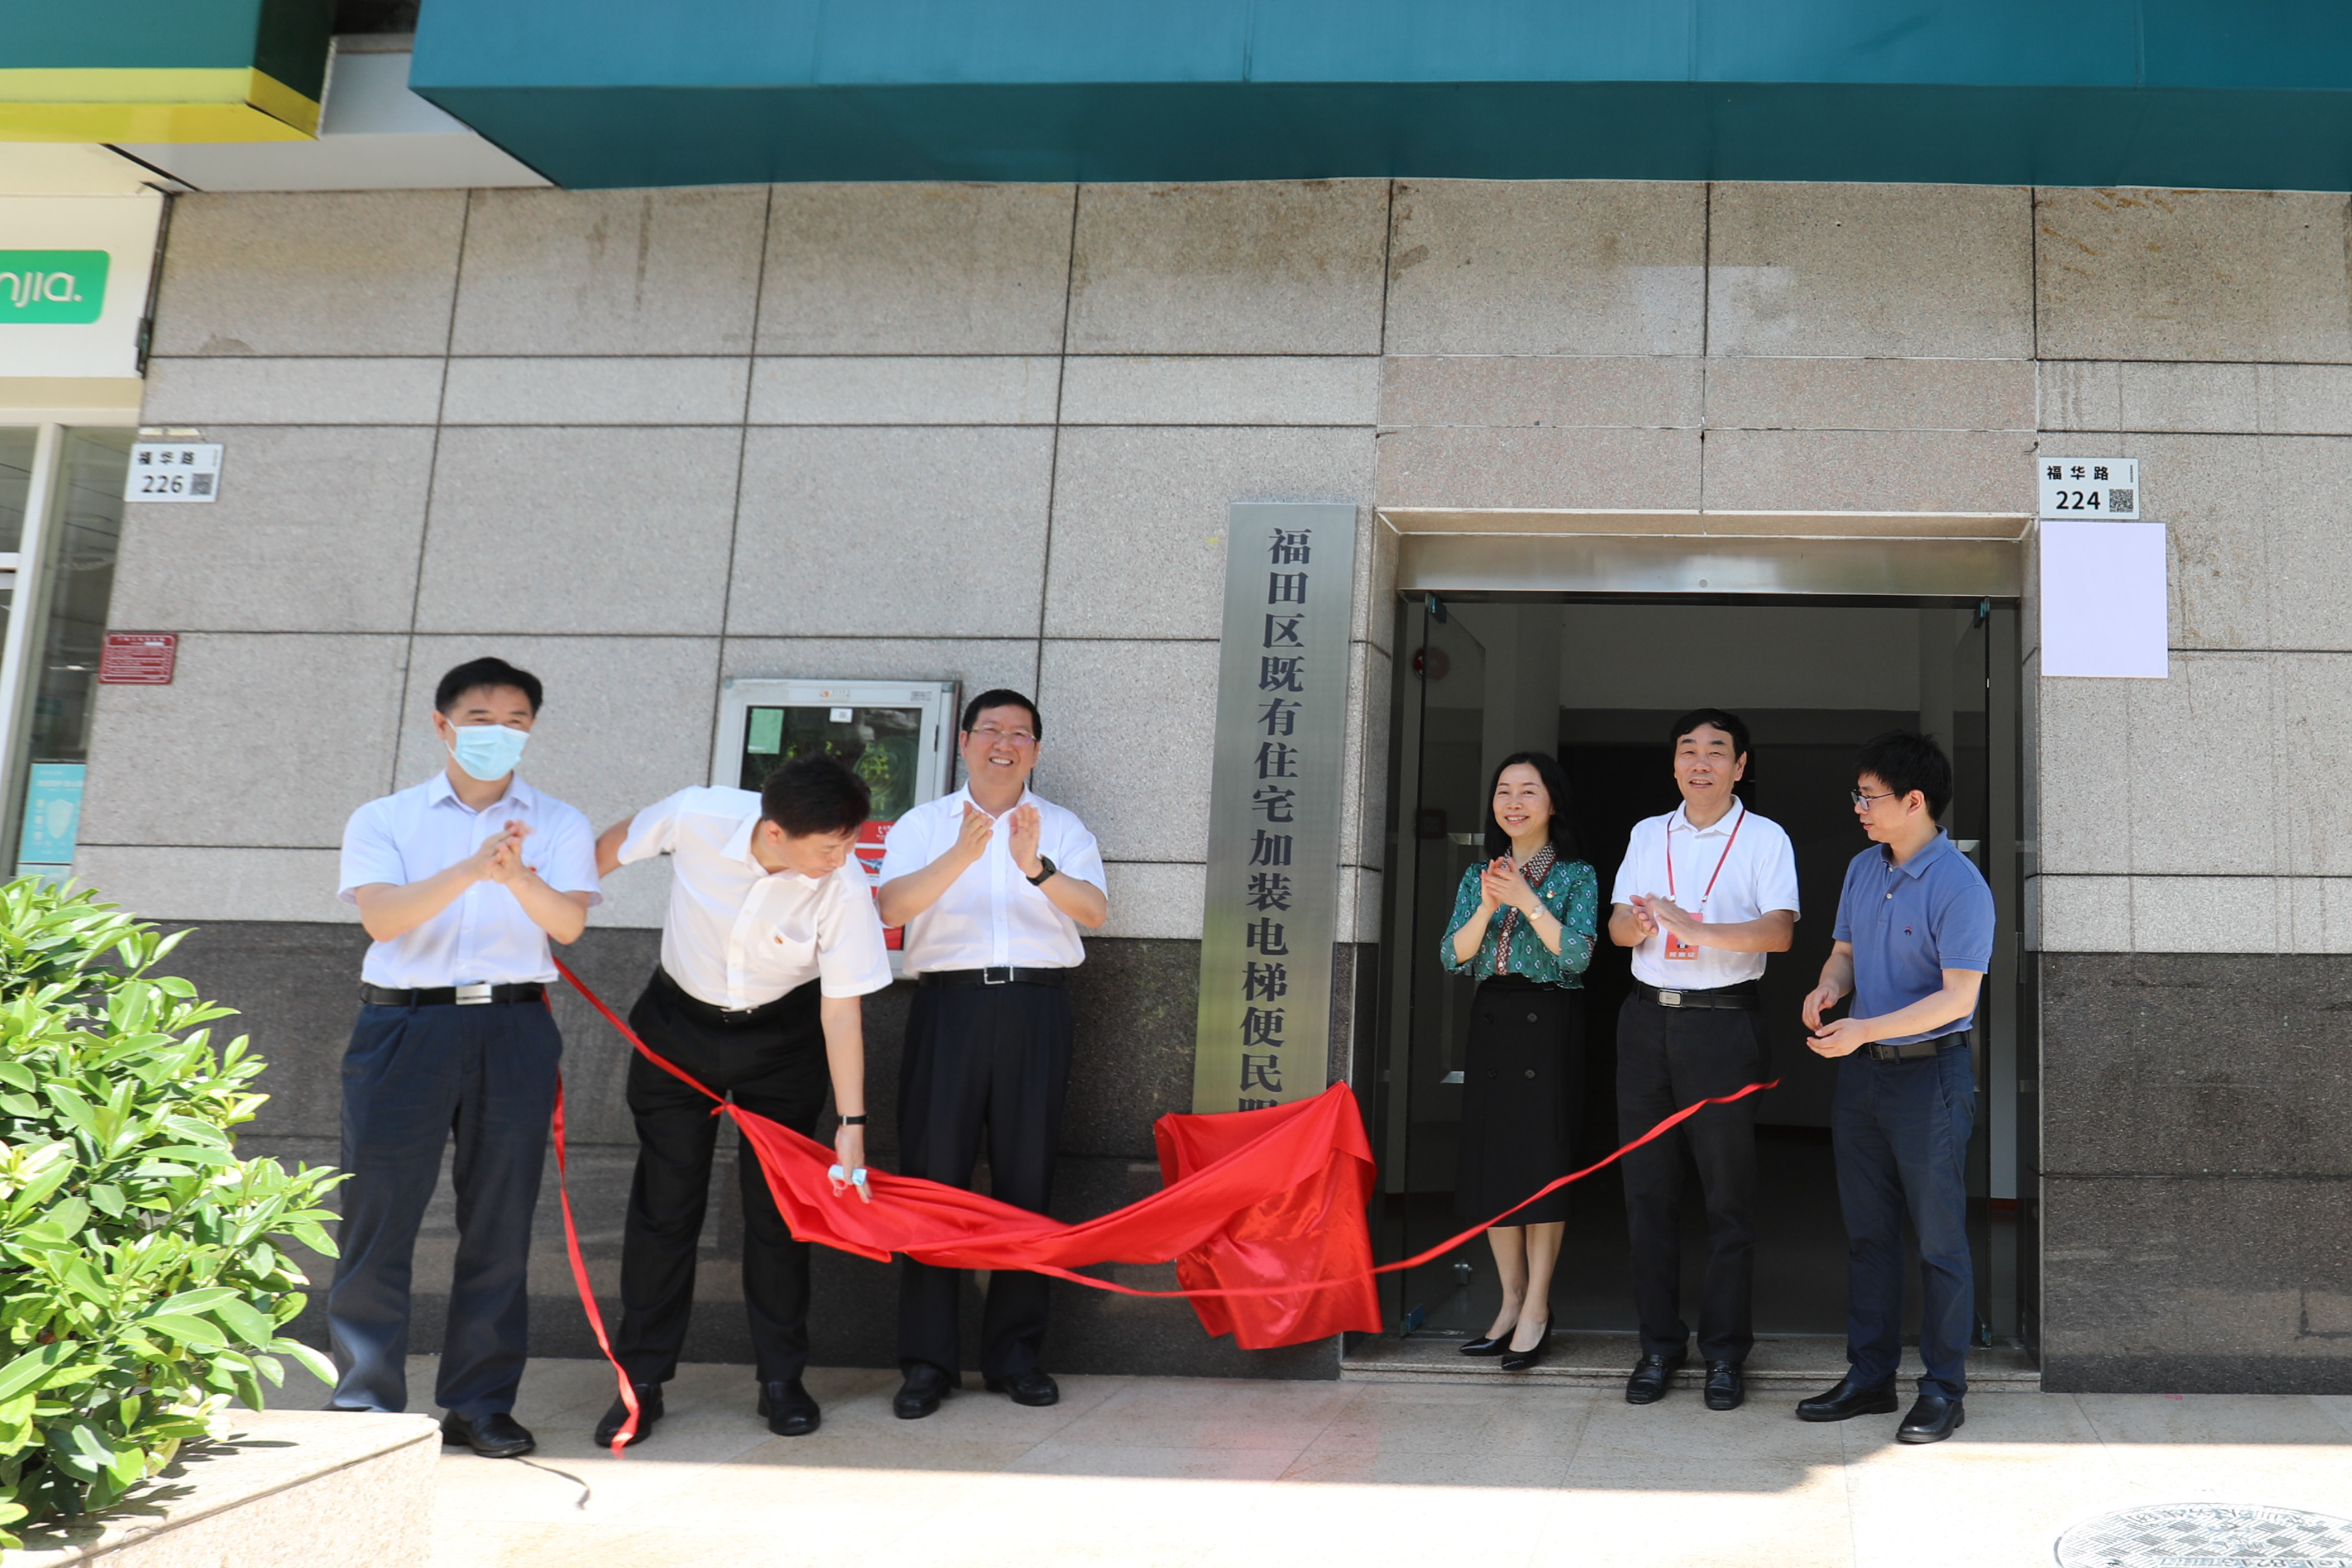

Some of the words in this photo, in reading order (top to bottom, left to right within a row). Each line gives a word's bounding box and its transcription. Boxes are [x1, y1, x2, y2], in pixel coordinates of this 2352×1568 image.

[2047, 466, 2109, 480] 福华路
[141, 475, 184, 493] 226
[2056, 491, 2101, 510] 224
[1238, 528, 1312, 1112] 福田区既有住宅加装电梯便民
